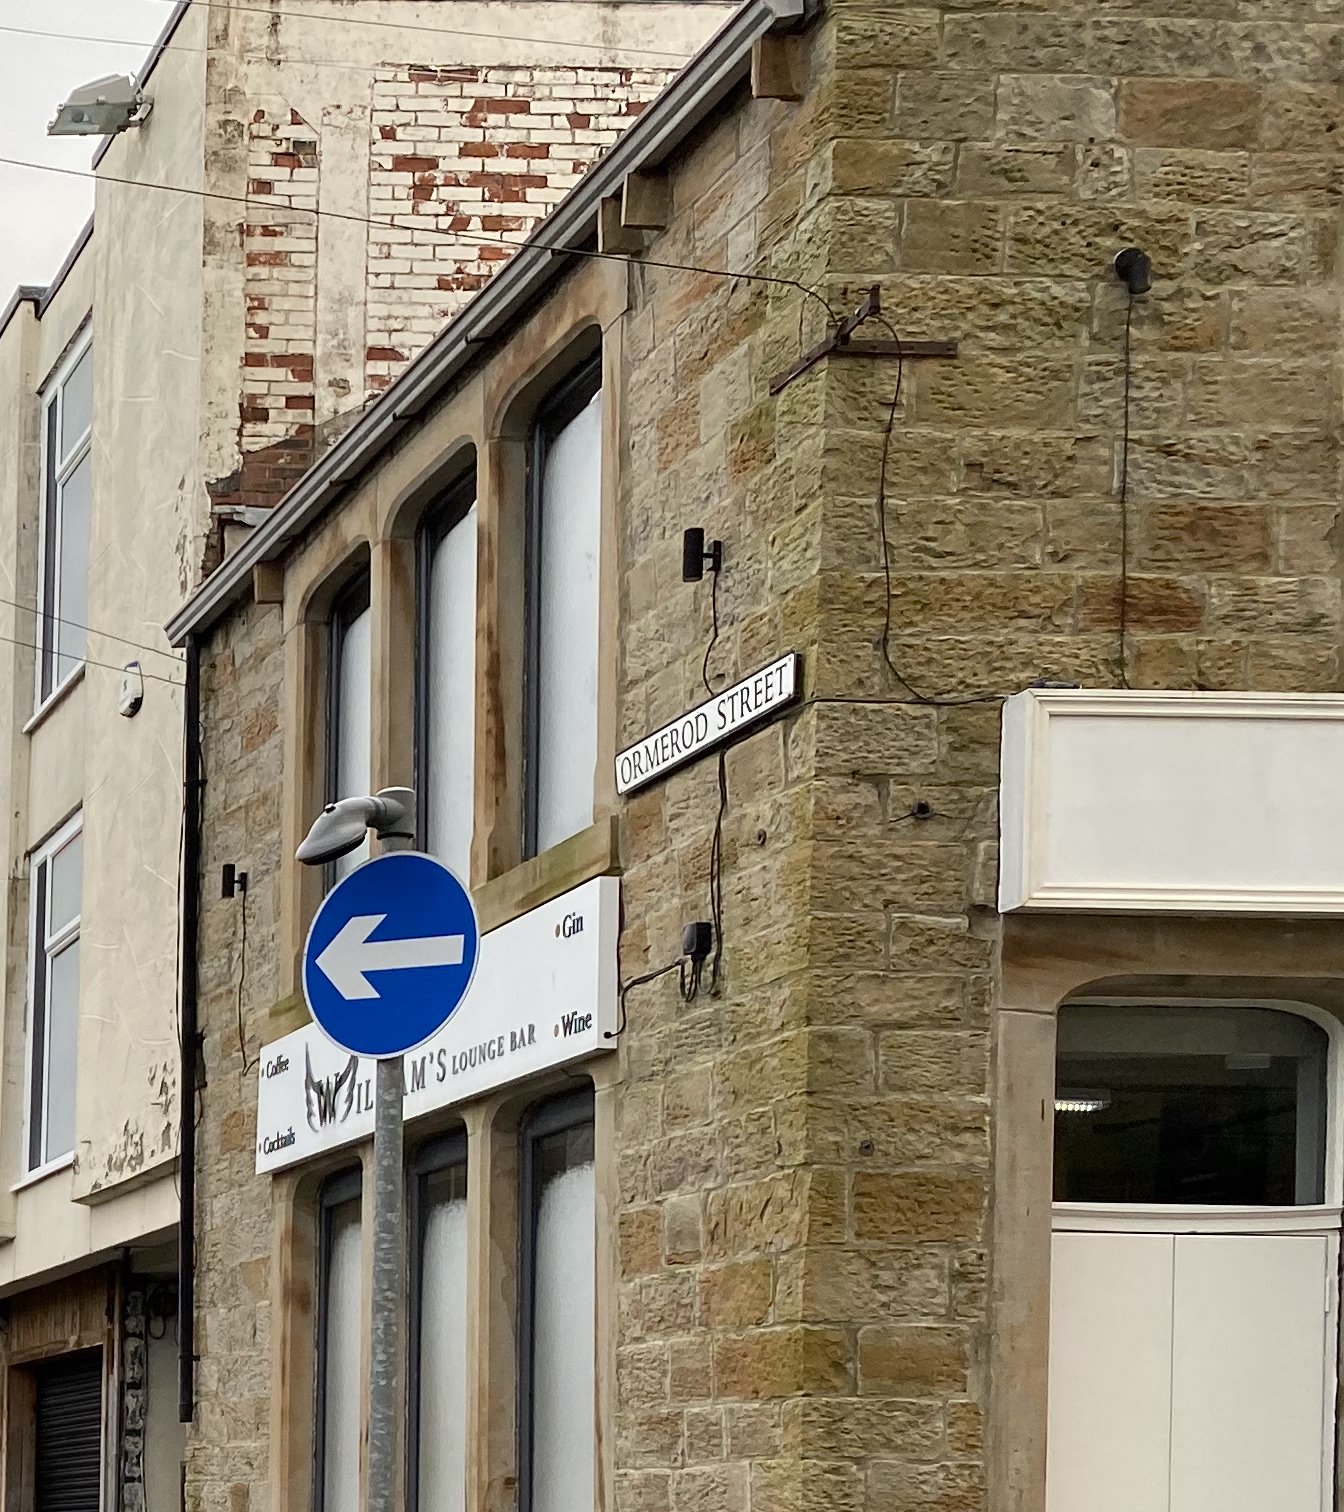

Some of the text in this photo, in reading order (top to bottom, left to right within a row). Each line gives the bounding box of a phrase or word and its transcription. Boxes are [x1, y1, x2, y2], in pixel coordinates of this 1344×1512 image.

[620, 663, 788, 785] ORMEROD STREET
[562, 912, 584, 938] Gin
[561, 1011, 592, 1038] Wine
[266, 1054, 290, 1079] Coffee
[307, 1023, 537, 1129] WILM'S LOUNGE BAR
[263, 1126, 296, 1154] Cocktails
